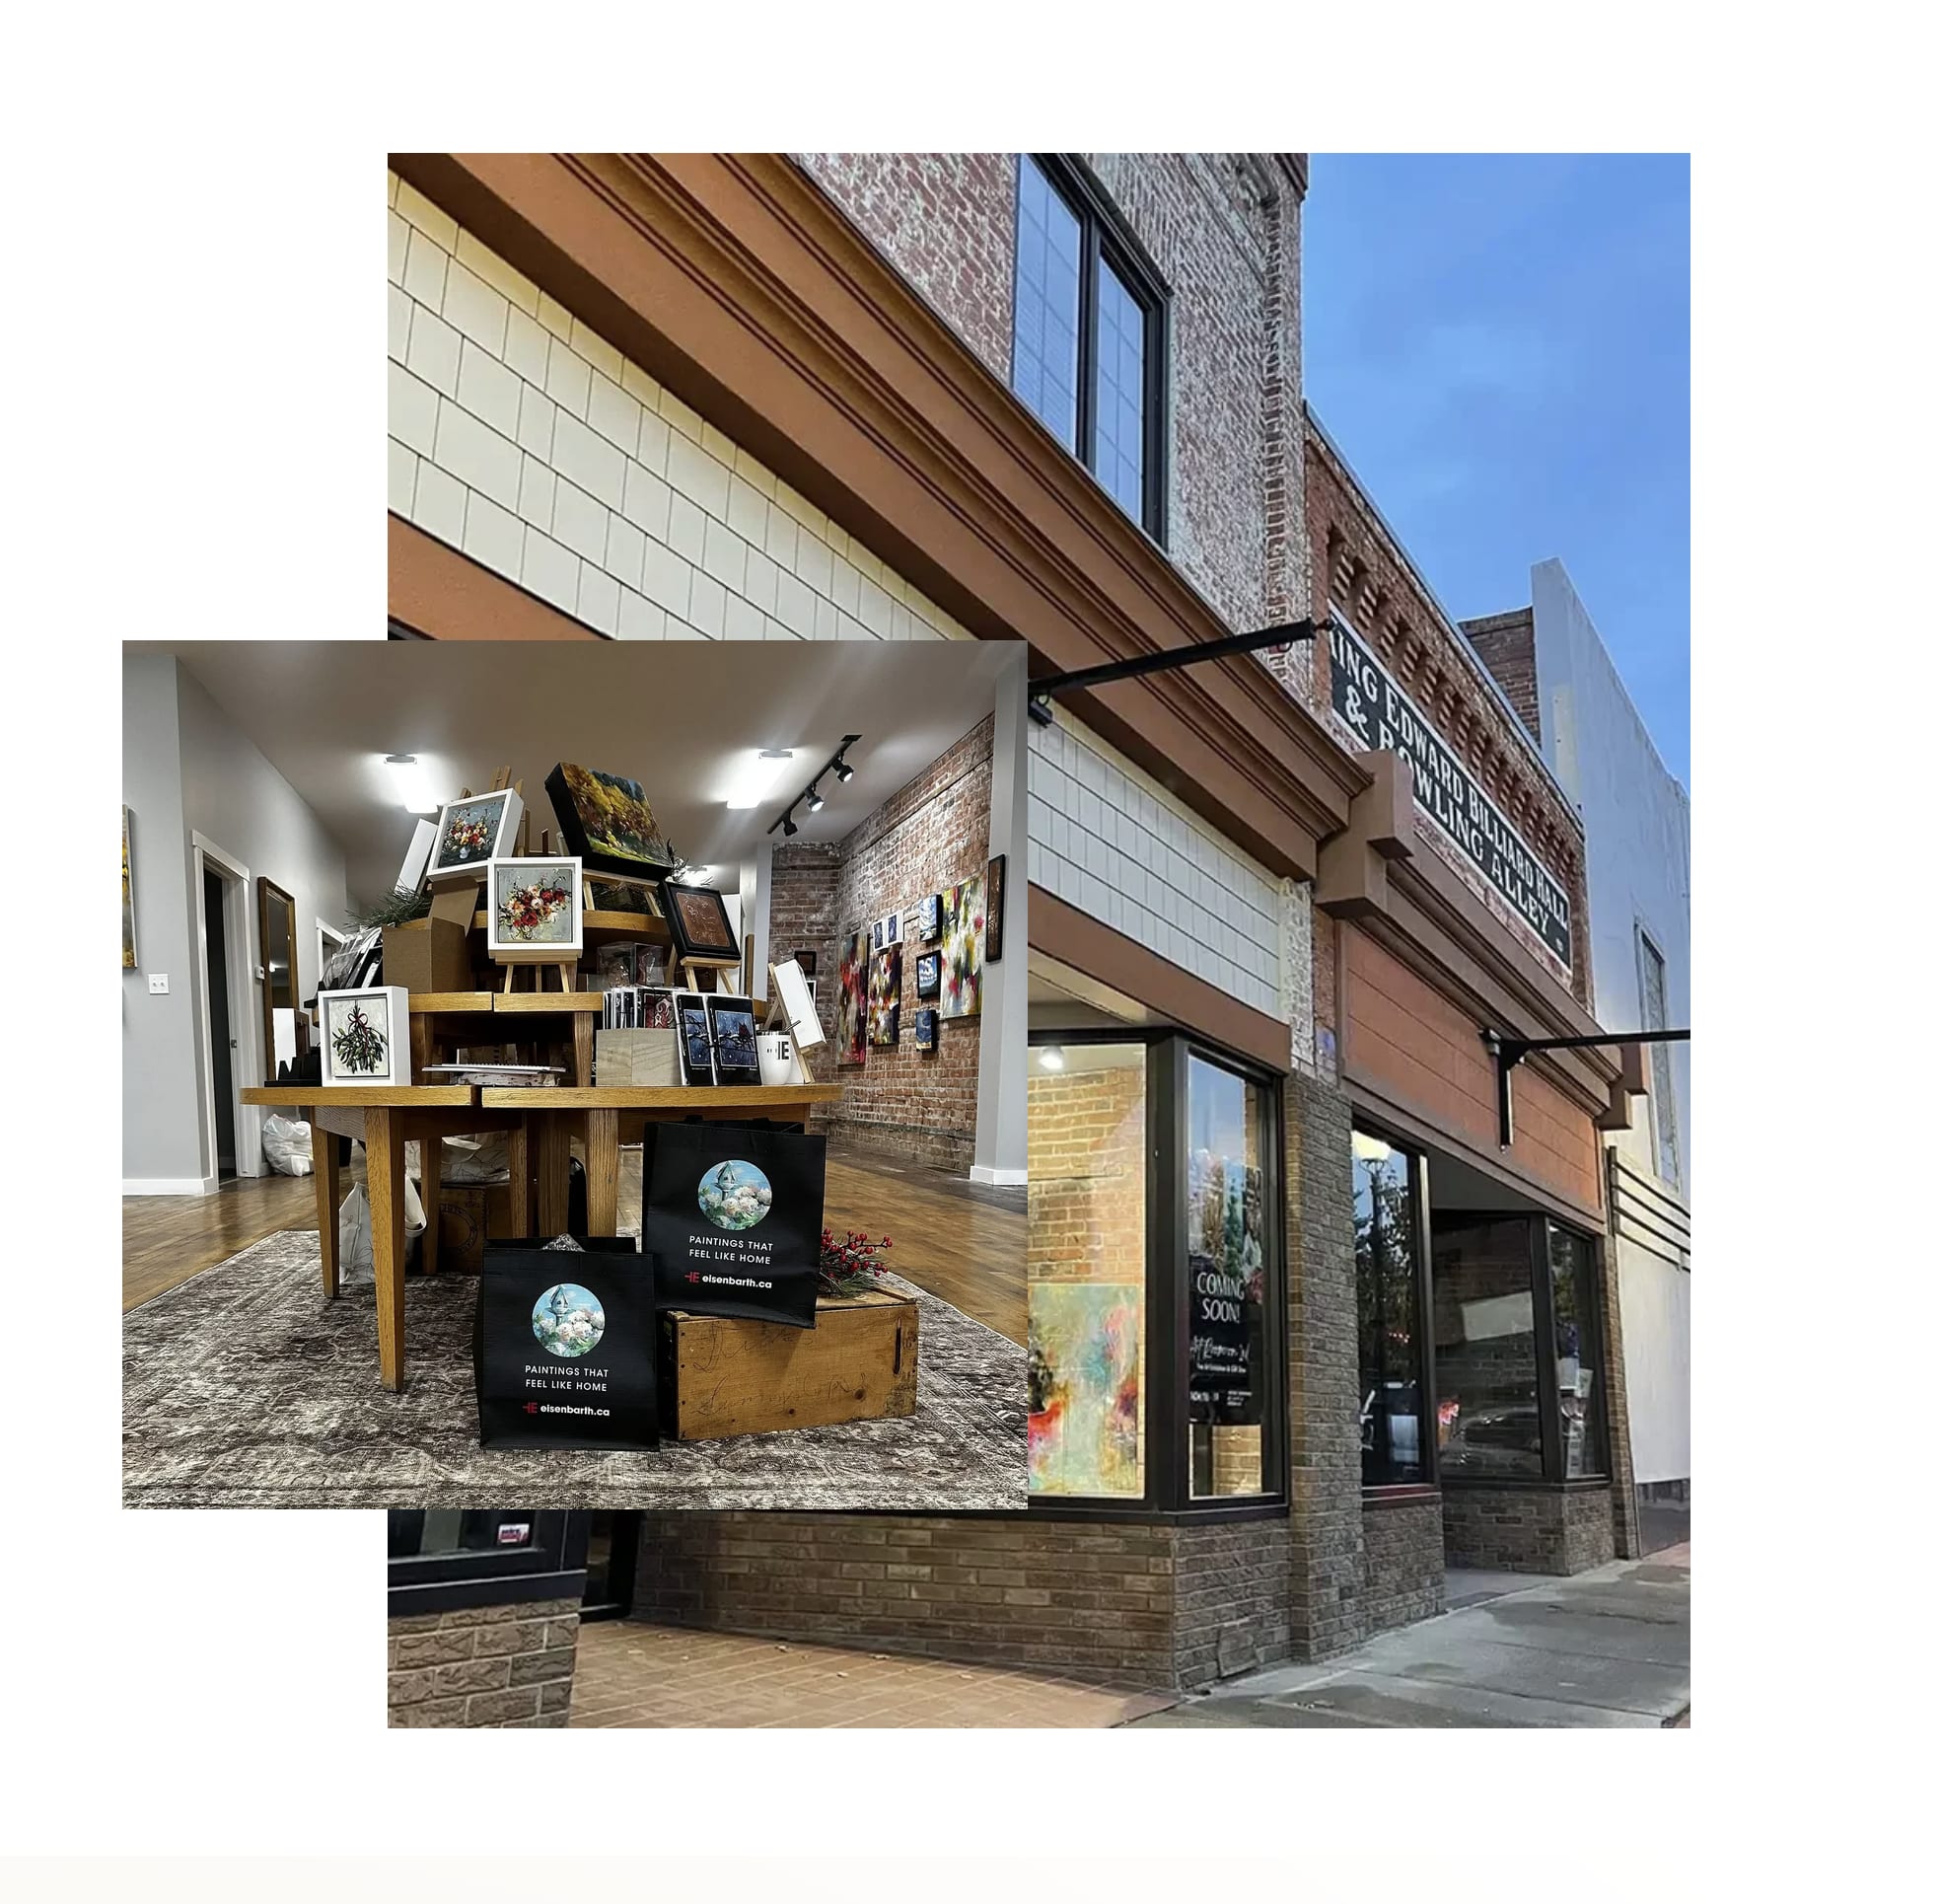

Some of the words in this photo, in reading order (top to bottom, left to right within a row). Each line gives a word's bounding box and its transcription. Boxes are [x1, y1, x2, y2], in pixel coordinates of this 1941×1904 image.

[1345, 685, 1370, 740] &
[1491, 851, 1548, 934] ALLEY
[1385, 682, 1463, 805] EDWARD
[1469, 784, 1534, 888] BILLIARD
[1536, 868, 1567, 932] HALL
[688, 1235, 745, 1249] PAINTINGS
[748, 1241, 773, 1252] THAT
[688, 1249, 711, 1259] FEEL
[714, 1251, 736, 1261] LIKE
[739, 1254, 771, 1265] HOME
[701, 1274, 772, 1289] eisenbarth.ca
[1196, 1272, 1245, 1300] COMING
[1201, 1297, 1241, 1324] SOON!
[525, 1364, 580, 1376] PAINTINGS
[584, 1367, 609, 1378] THAT
[525, 1378, 547, 1388] FEEL
[551, 1380, 572, 1390] LIKE
[576, 1381, 608, 1392] HOME
[539, 1404, 611, 1417] eisenbarth.ca
